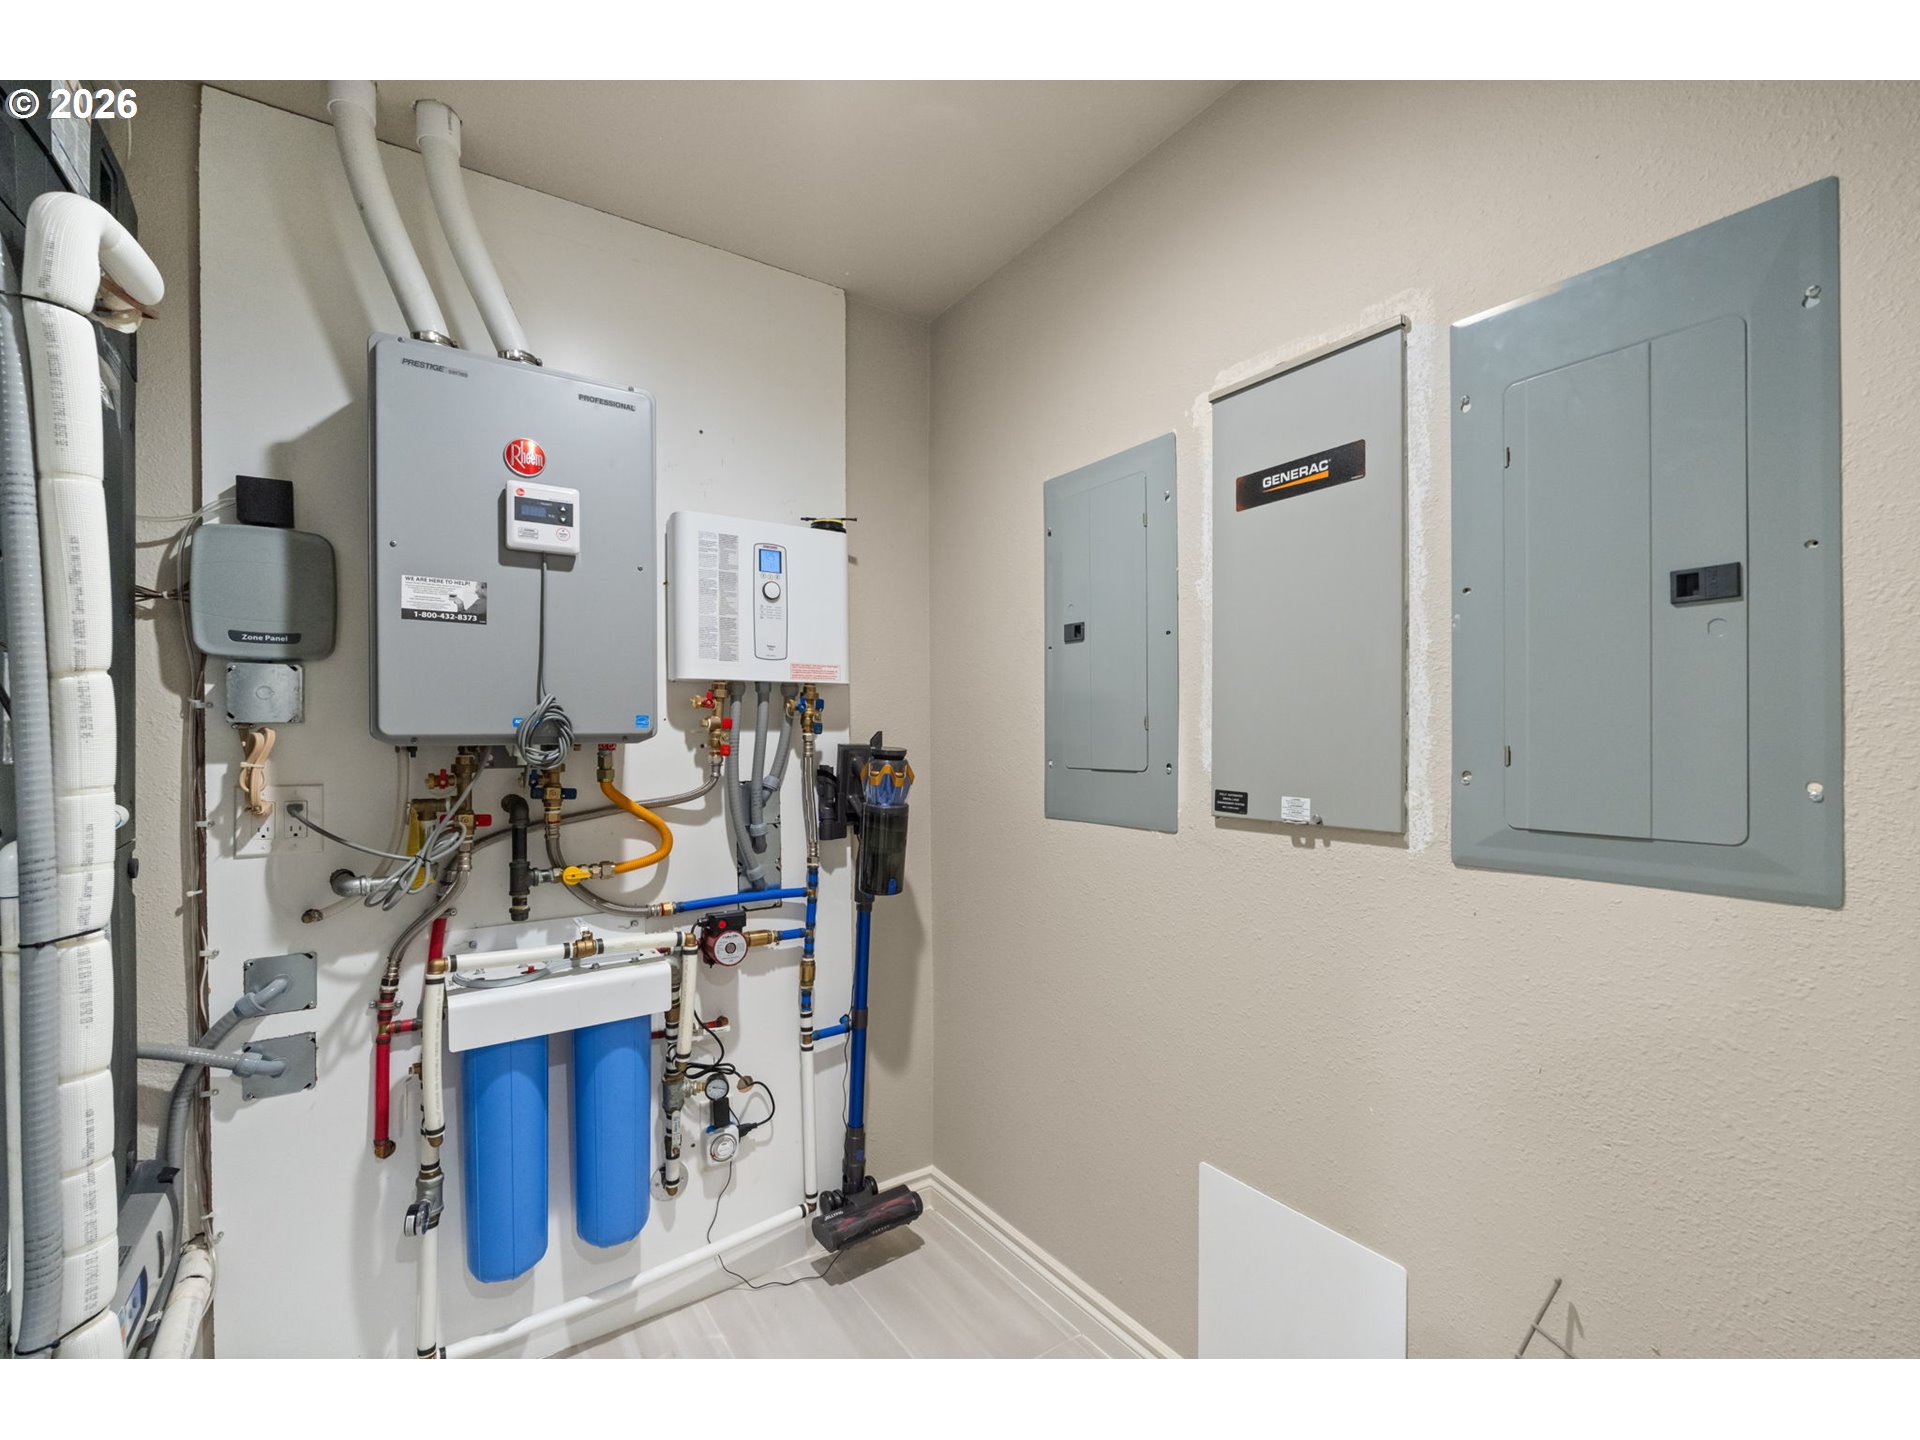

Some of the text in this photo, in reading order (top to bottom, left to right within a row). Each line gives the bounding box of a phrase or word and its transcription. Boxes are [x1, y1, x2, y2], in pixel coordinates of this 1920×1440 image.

[402, 357, 446, 373] PRESTIGE
[578, 393, 636, 412] PROFESSIONAL
[510, 441, 544, 469] Rheem
[1262, 459, 1329, 488] GENERAC
[414, 610, 478, 622] 1-800-432-8373
[241, 633, 288, 642] Zone Panel
